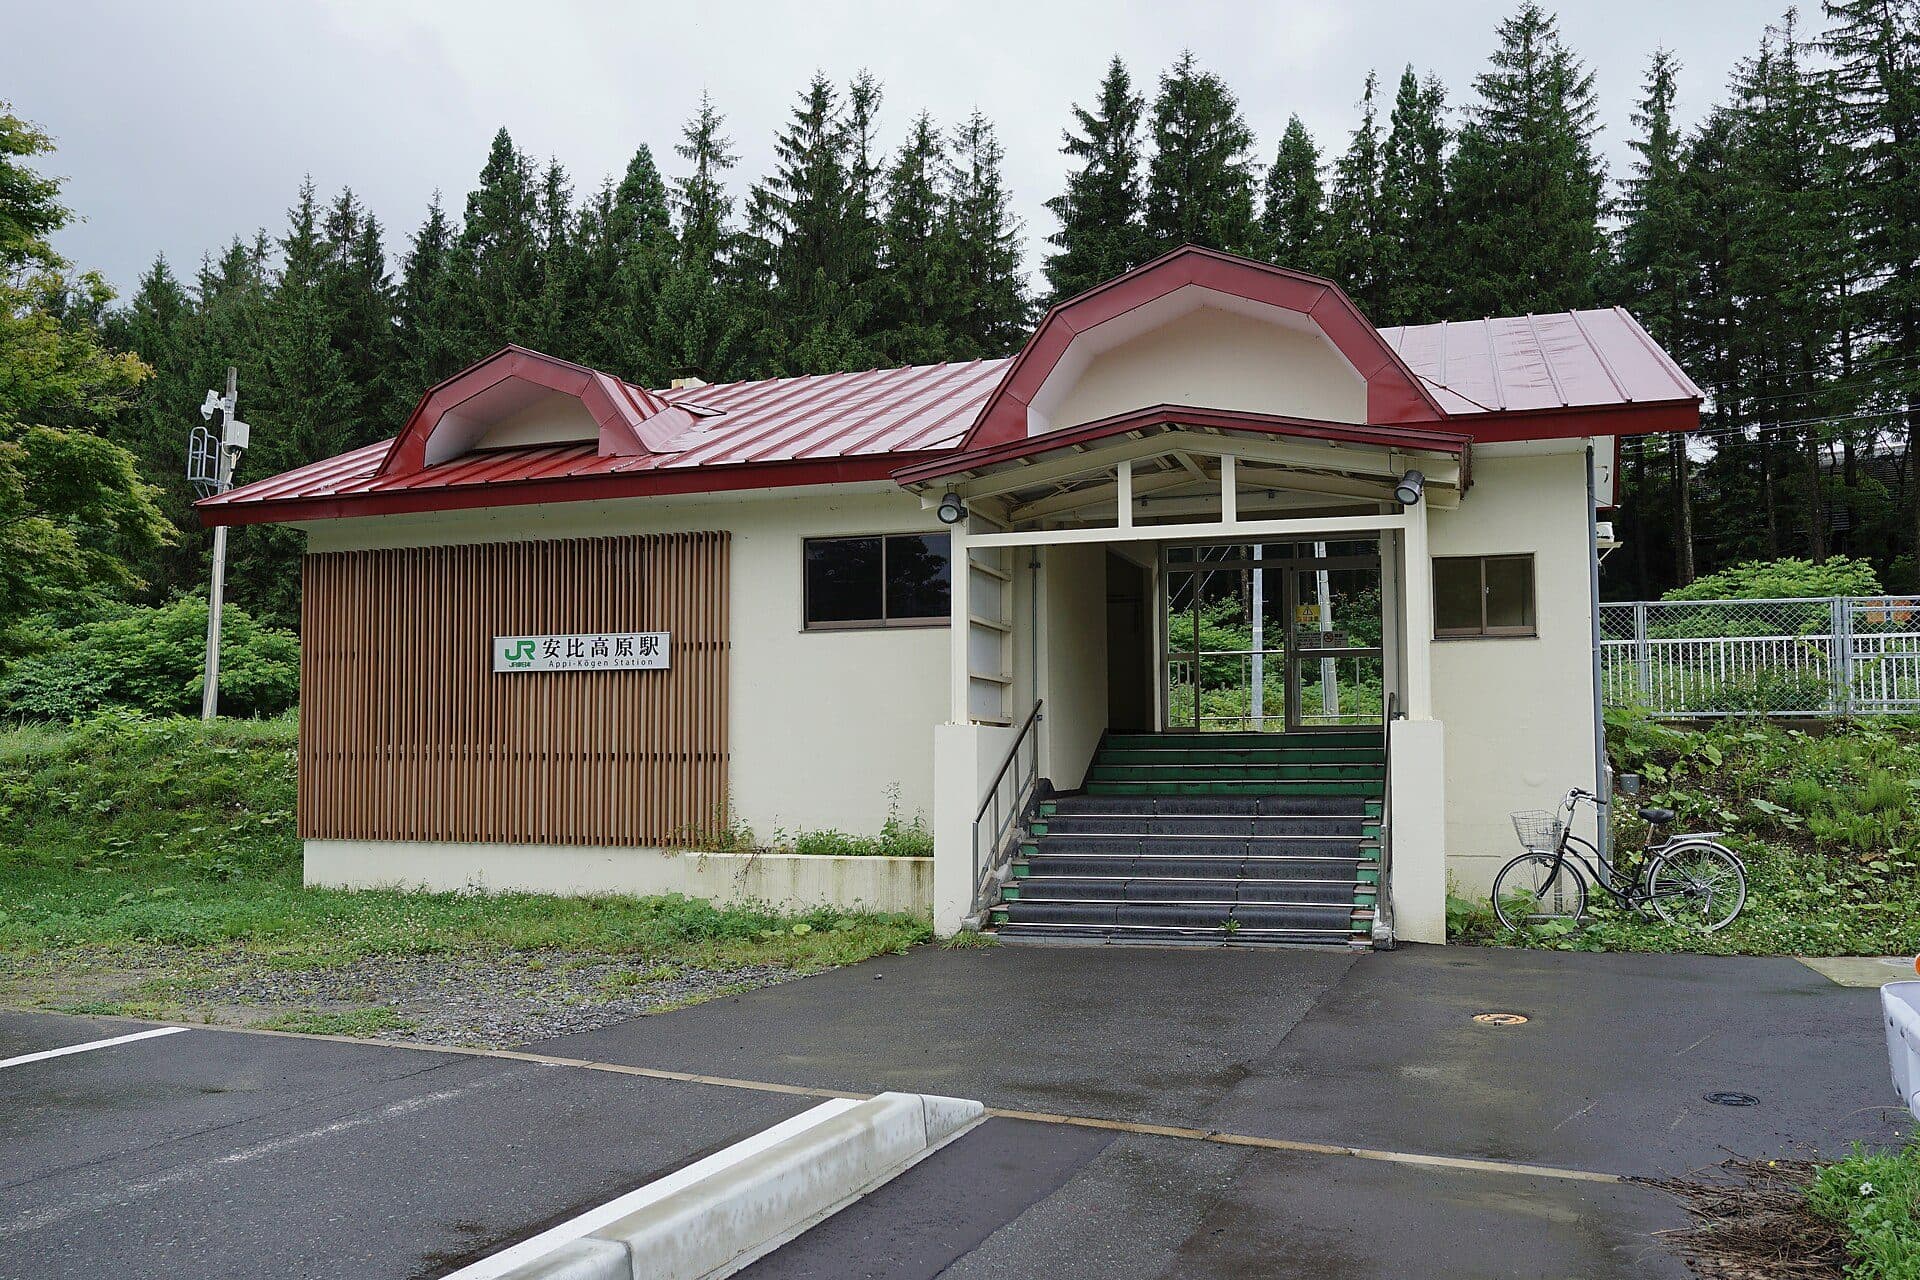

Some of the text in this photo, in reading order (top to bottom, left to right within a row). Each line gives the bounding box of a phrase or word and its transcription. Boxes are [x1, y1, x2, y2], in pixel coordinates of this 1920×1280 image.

[505, 641, 536, 660] JR
[543, 635, 659, 659] 安比高原駅
[615, 658, 653, 666] Station
